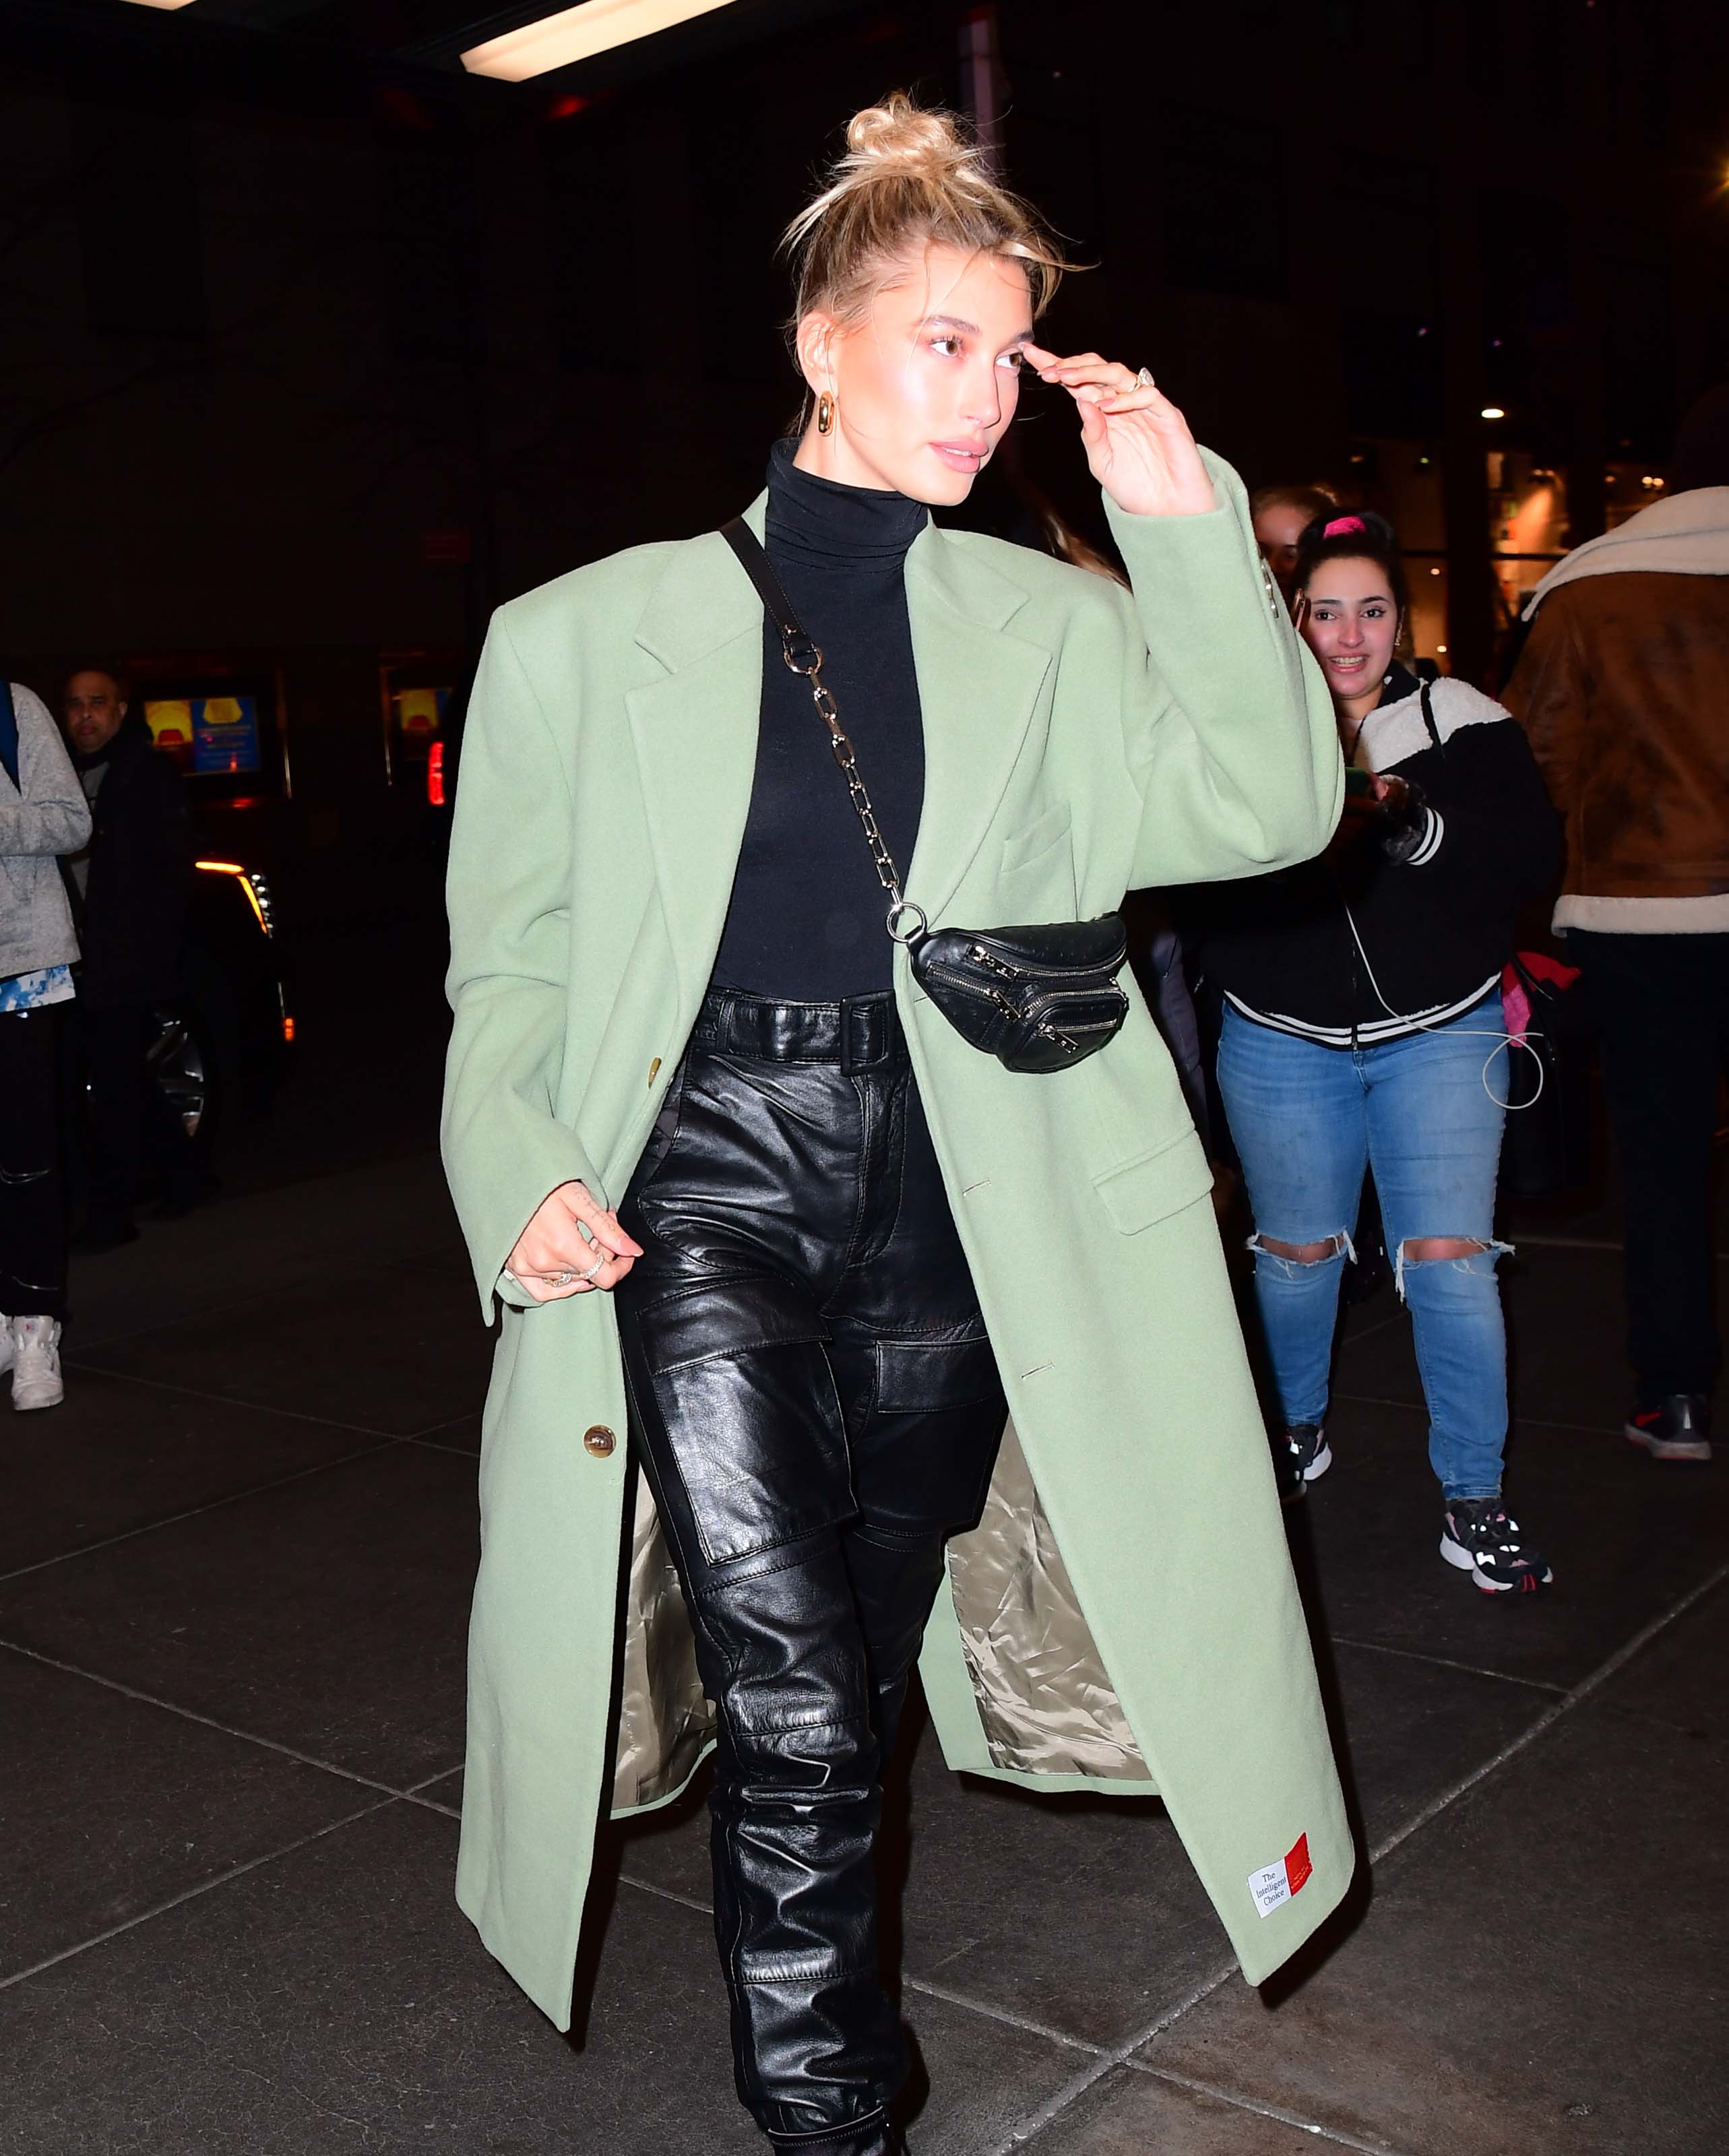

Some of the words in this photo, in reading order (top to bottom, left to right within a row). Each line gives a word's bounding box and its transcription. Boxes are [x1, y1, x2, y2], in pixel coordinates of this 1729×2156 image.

[1262, 1872, 1276, 1882] The
[1256, 1876, 1286, 1899] Intelligent
[1263, 1889, 1284, 1906] Choice
